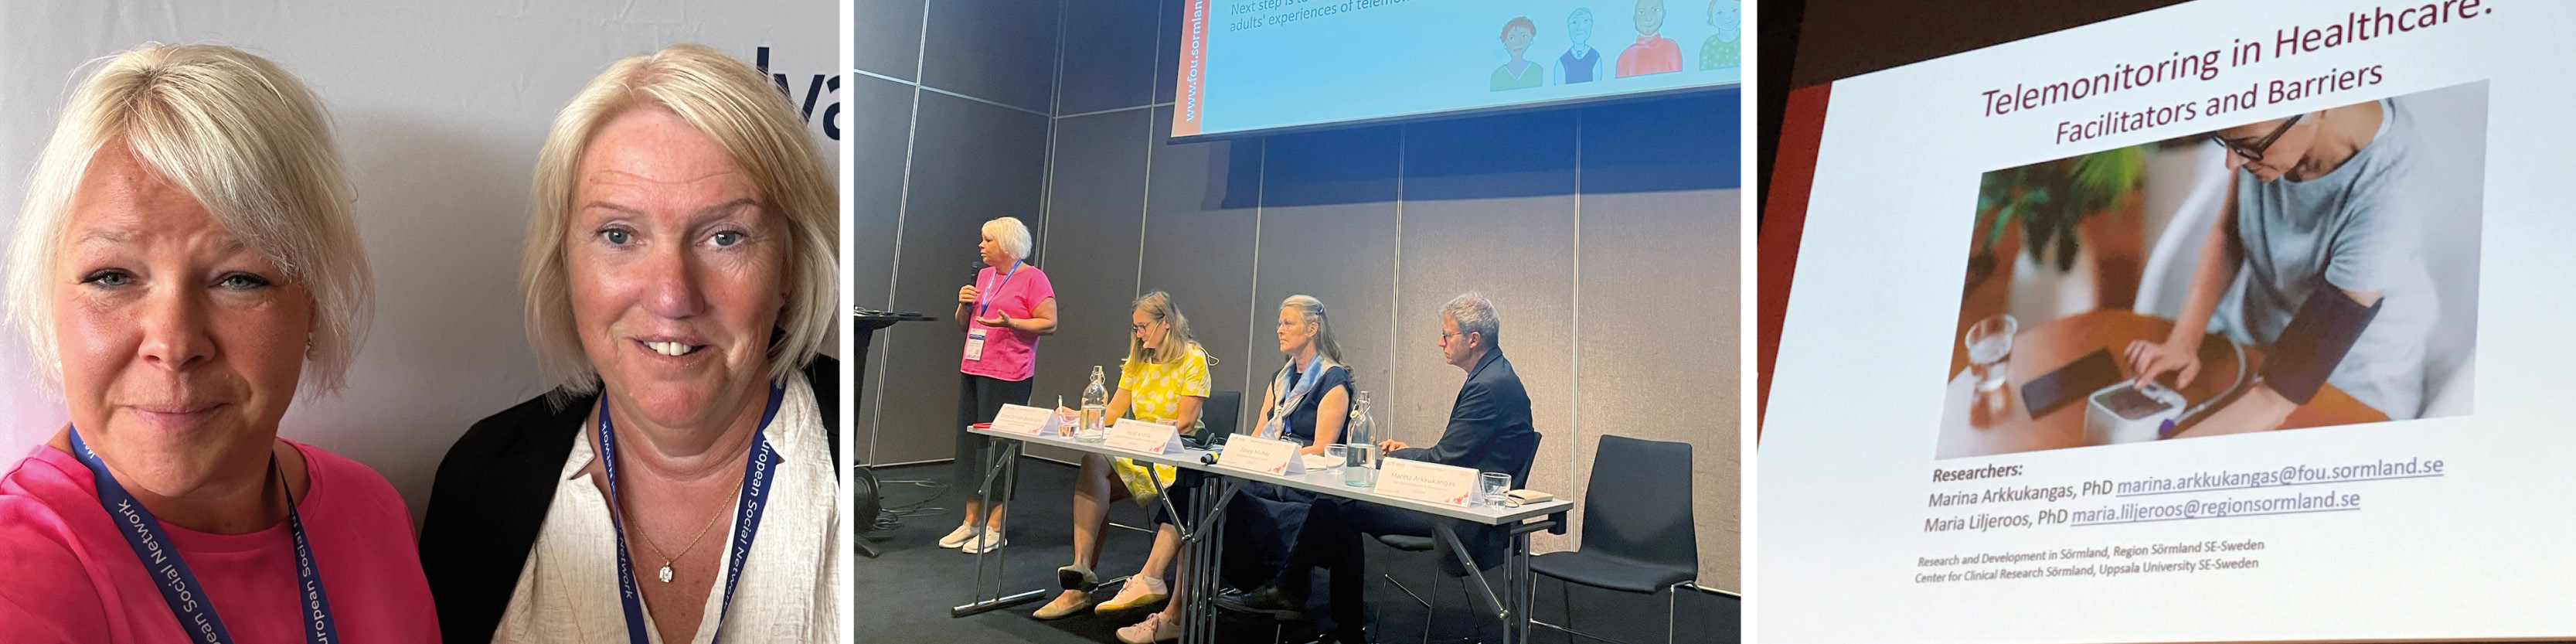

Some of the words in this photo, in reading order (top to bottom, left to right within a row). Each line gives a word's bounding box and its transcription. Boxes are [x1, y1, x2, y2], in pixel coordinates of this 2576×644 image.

[1230, 14, 1266, 32] adults'
[1268, 5, 1337, 26] experiences
[1340, 0, 1353, 12] of
[1231, 2, 1256, 15] Next
[1258, 0, 1281, 10] step
[1982, 49, 2220, 118] Telemonitoring
[2231, 39, 2261, 67] in
[2056, 101, 2197, 145] Facilitators
[2205, 83, 2258, 117] and
[2268, 64, 2383, 105] Barriers
[1413, 476, 1455, 487] Arkkukangas
[1928, 491, 1978, 507] Marina
[1982, 483, 2077, 503] Arkkukangas,
[2081, 480, 2113, 497] PhD
[2116, 457, 2445, 497] marina.arkkukangas@fou.sormland.se
[1932, 464, 2023, 482] Researchers:
[117, 498, 168, 565] Network
[740, 499, 758, 544] Social
[1924, 516, 1965, 533] Maria
[1969, 513, 2033, 532] Liljeroos,
[2037, 509, 2068, 525] PhD
[2071, 490, 2361, 526] maria.liljeroos@regionsormland.se
[295, 531, 311, 578] Social
[619, 537, 634, 600] Network
[1915, 571, 1947, 584] Center
[1948, 571, 1962, 582] for
[1964, 568, 1998, 582] Clinical
[1999, 566, 2044, 580] Research
[2046, 563, 2096, 578] Sörmland,
[2098, 561, 2140, 577] Uppsala
[2142, 558, 2197, 576] University
[2198, 556, 2259, 571] SE-Sweden
[1918, 554, 1959, 567] Research
[1962, 553, 1979, 565] and
[1982, 547, 2047, 565] Development
[2048, 549, 2057, 561] in
[2060, 546, 2111, 561] Sörmland,
[2113, 545, 2149, 557] Region
[2151, 541, 2202, 556] Sörmland
[2203, 539, 2265, 553] SE-Sweden
[160, 564, 198, 613] Social
[723, 546, 745, 610] Network
